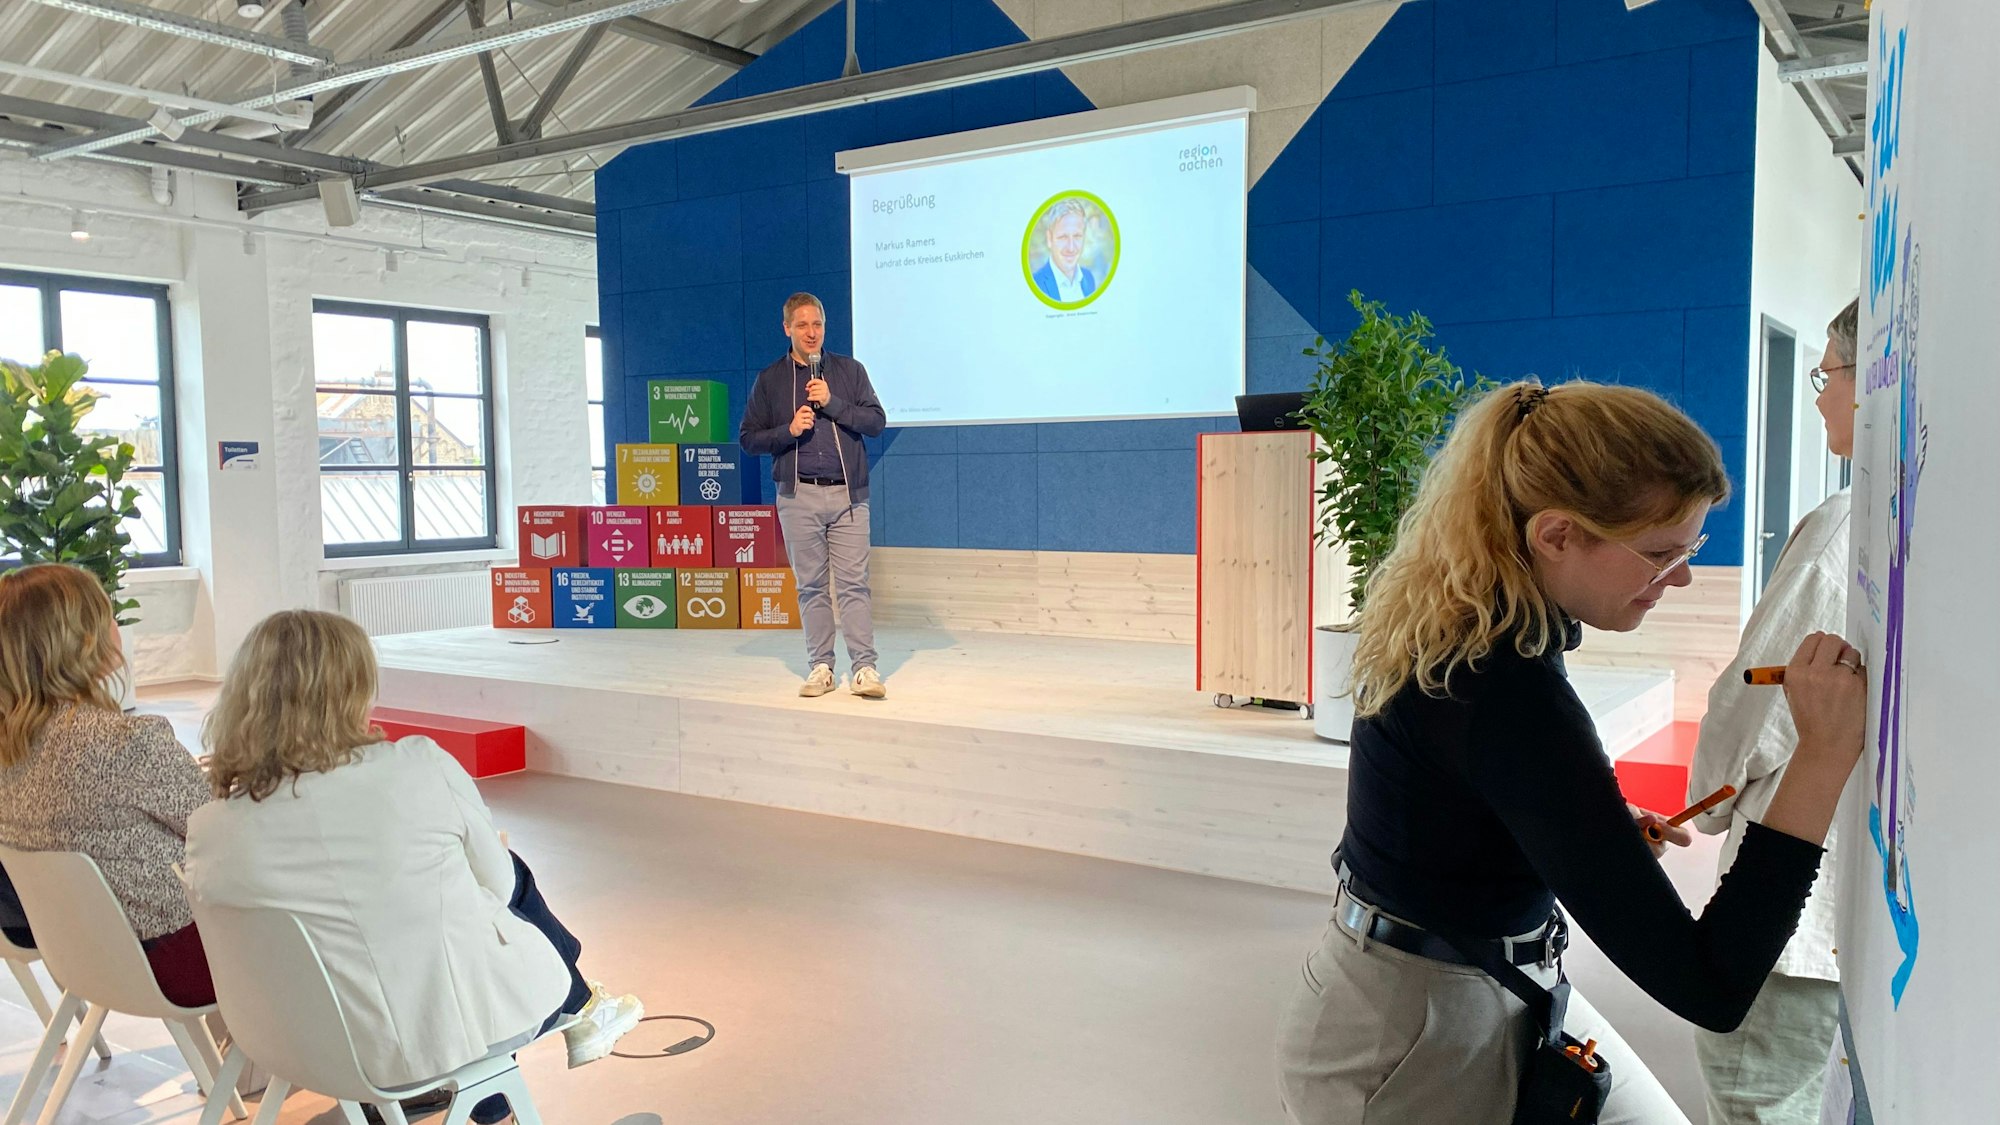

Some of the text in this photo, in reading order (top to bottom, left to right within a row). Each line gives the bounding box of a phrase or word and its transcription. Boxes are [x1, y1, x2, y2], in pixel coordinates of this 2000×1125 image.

[1179, 144, 1218, 160] region
[1179, 156, 1223, 172] aachen
[872, 193, 936, 214] Begrüßung
[875, 238, 936, 252] Markus Ramers
[875, 249, 985, 269] Landrat des Kreises Euskirchen
[653, 386, 660, 400] 3
[622, 449, 628, 463] 7
[684, 448, 695, 463] 17
[522, 511, 530, 525] 4
[591, 511, 604, 525] 10
[656, 511, 662, 525] 1
[718, 511, 726, 525] 8
[495, 572, 502, 586] 9
[556, 572, 569, 586] 16
[618, 572, 629, 587] 13
[680, 573, 692, 587] 12
[744, 573, 753, 586] 11
